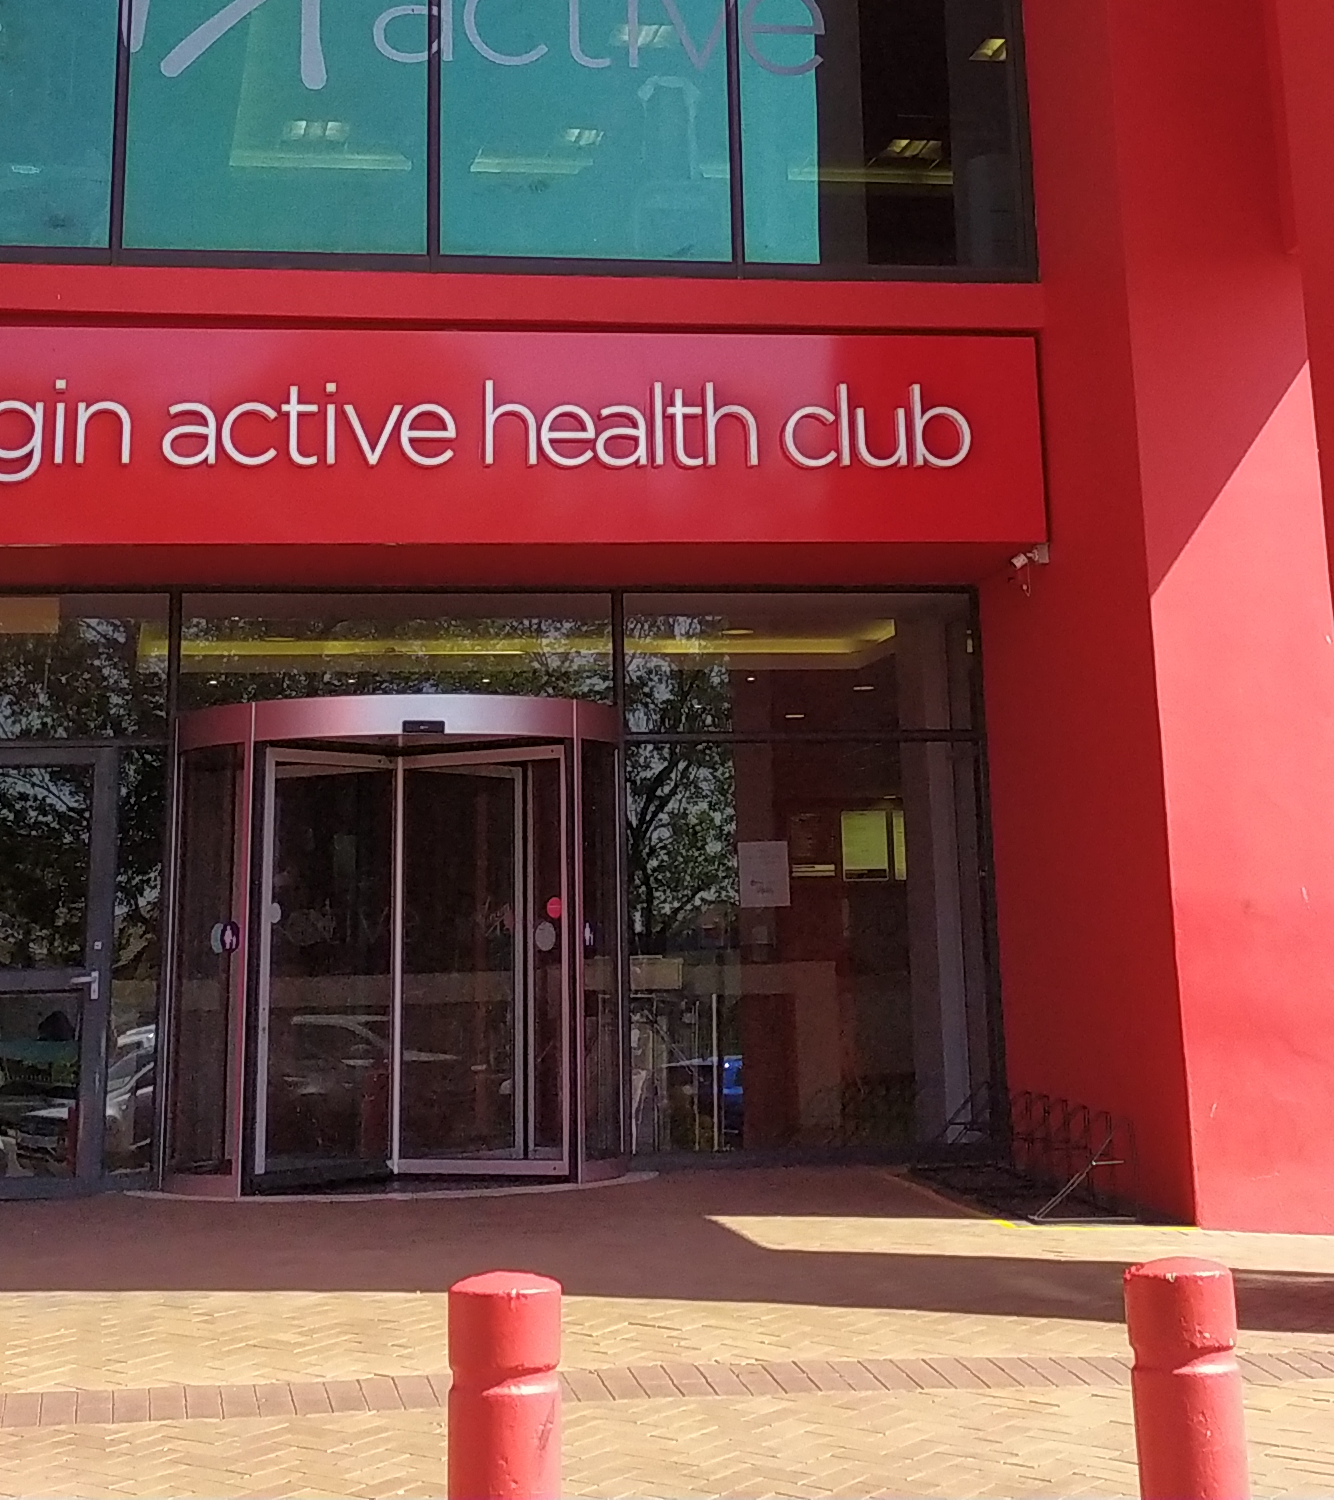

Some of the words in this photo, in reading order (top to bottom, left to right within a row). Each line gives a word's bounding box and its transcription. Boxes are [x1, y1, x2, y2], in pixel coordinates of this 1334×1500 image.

[161, 381, 457, 467] active
[481, 378, 759, 468] health
[781, 382, 973, 468] club
